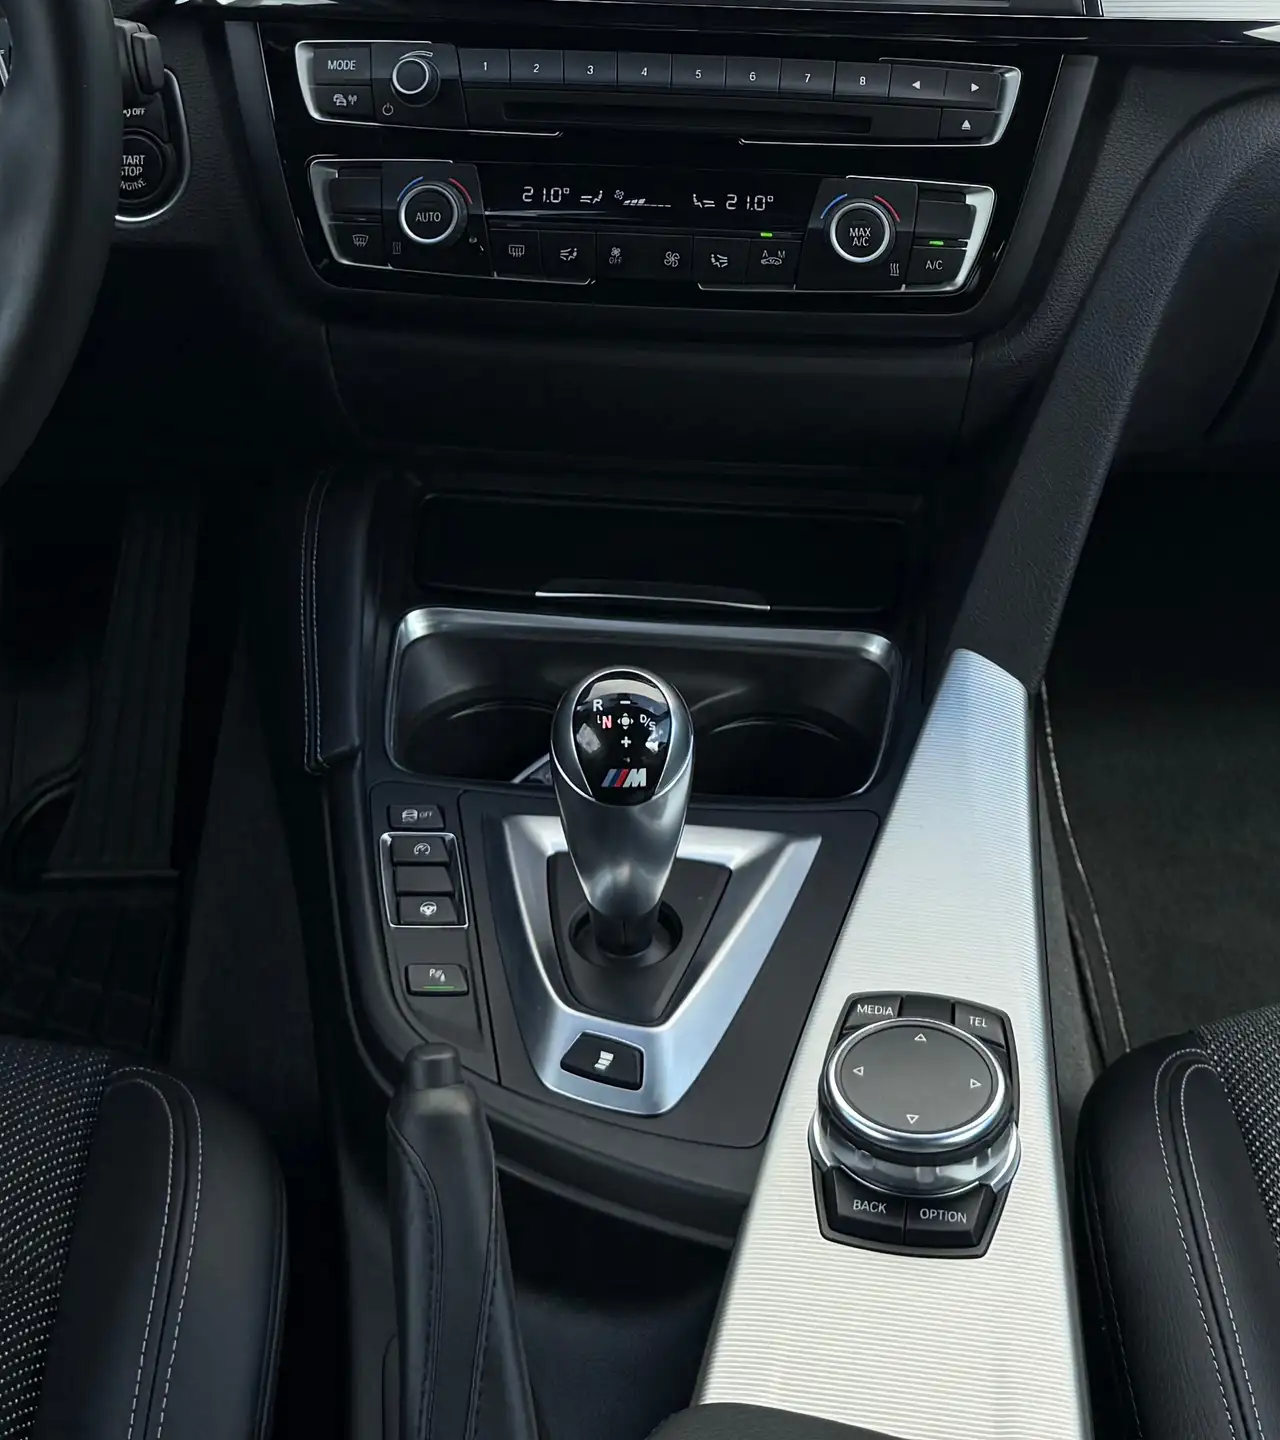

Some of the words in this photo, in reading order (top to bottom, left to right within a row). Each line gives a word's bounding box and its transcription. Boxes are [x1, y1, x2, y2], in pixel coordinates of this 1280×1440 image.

[327, 59, 356, 71] MODE
[483, 61, 488, 71] 1
[533, 63, 540, 73] 2
[587, 65, 594, 75] 3
[641, 67, 648, 76] 4
[695, 69, 702, 79] 5
[749, 71, 756, 81] 6
[804, 73, 811, 83] 7
[859, 76, 866, 86] 8
[132, 107, 146, 116] OFF
[121, 154, 146, 165] TART
[119, 177, 147, 191] NGINE
[415, 211, 442, 223] AUTO
[849, 227, 871, 237] MAX
[852, 236, 869, 247] A/C
[925, 260, 943, 271] A/C
[593, 699, 603, 712] R
[602, 714, 612, 729] N
[639, 713, 657, 731] D/S
[857, 1003, 894, 1016] MEDIA
[969, 1015, 988, 1028] TEL
[853, 1199, 887, 1215] BACK
[920, 1208, 967, 1224] OPTION
